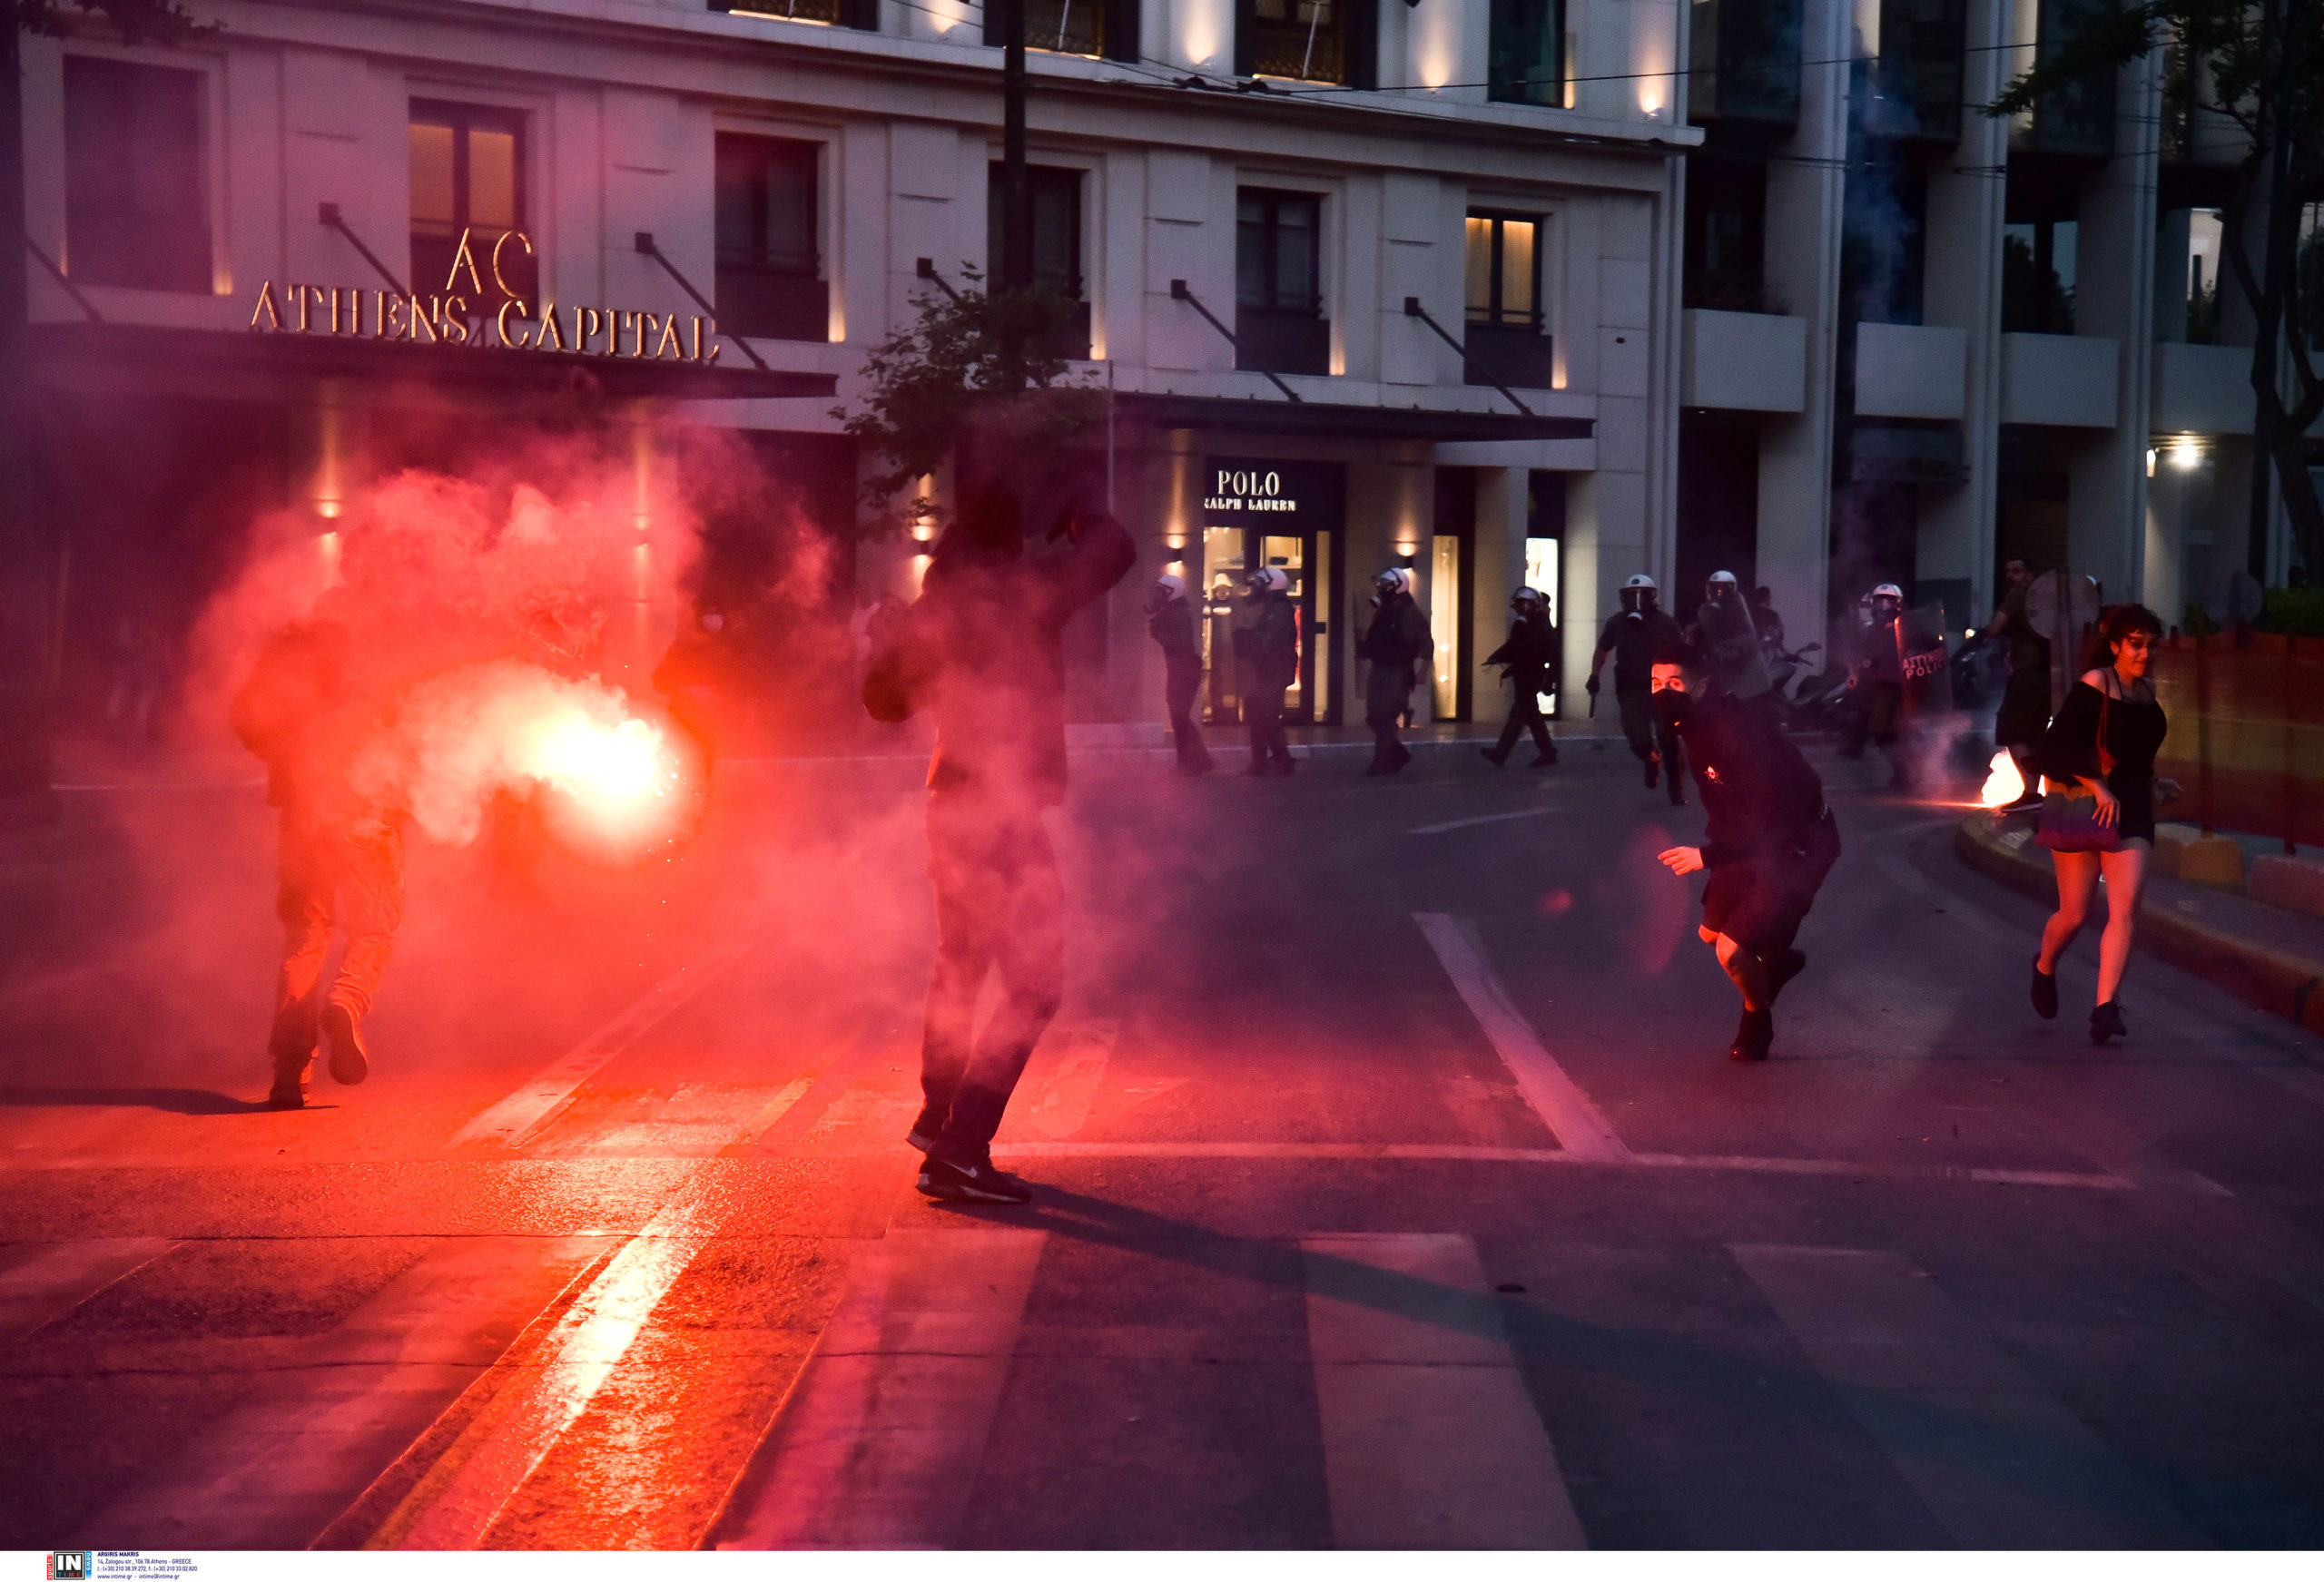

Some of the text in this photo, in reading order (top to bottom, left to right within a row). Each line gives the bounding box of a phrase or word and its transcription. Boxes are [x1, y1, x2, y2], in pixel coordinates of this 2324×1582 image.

[446, 227, 533, 298] AC
[250, 280, 720, 362] ATHENS CAPITAL
[1217, 470, 1280, 496] POLO
[1248, 499, 1296, 512] LAUREN
